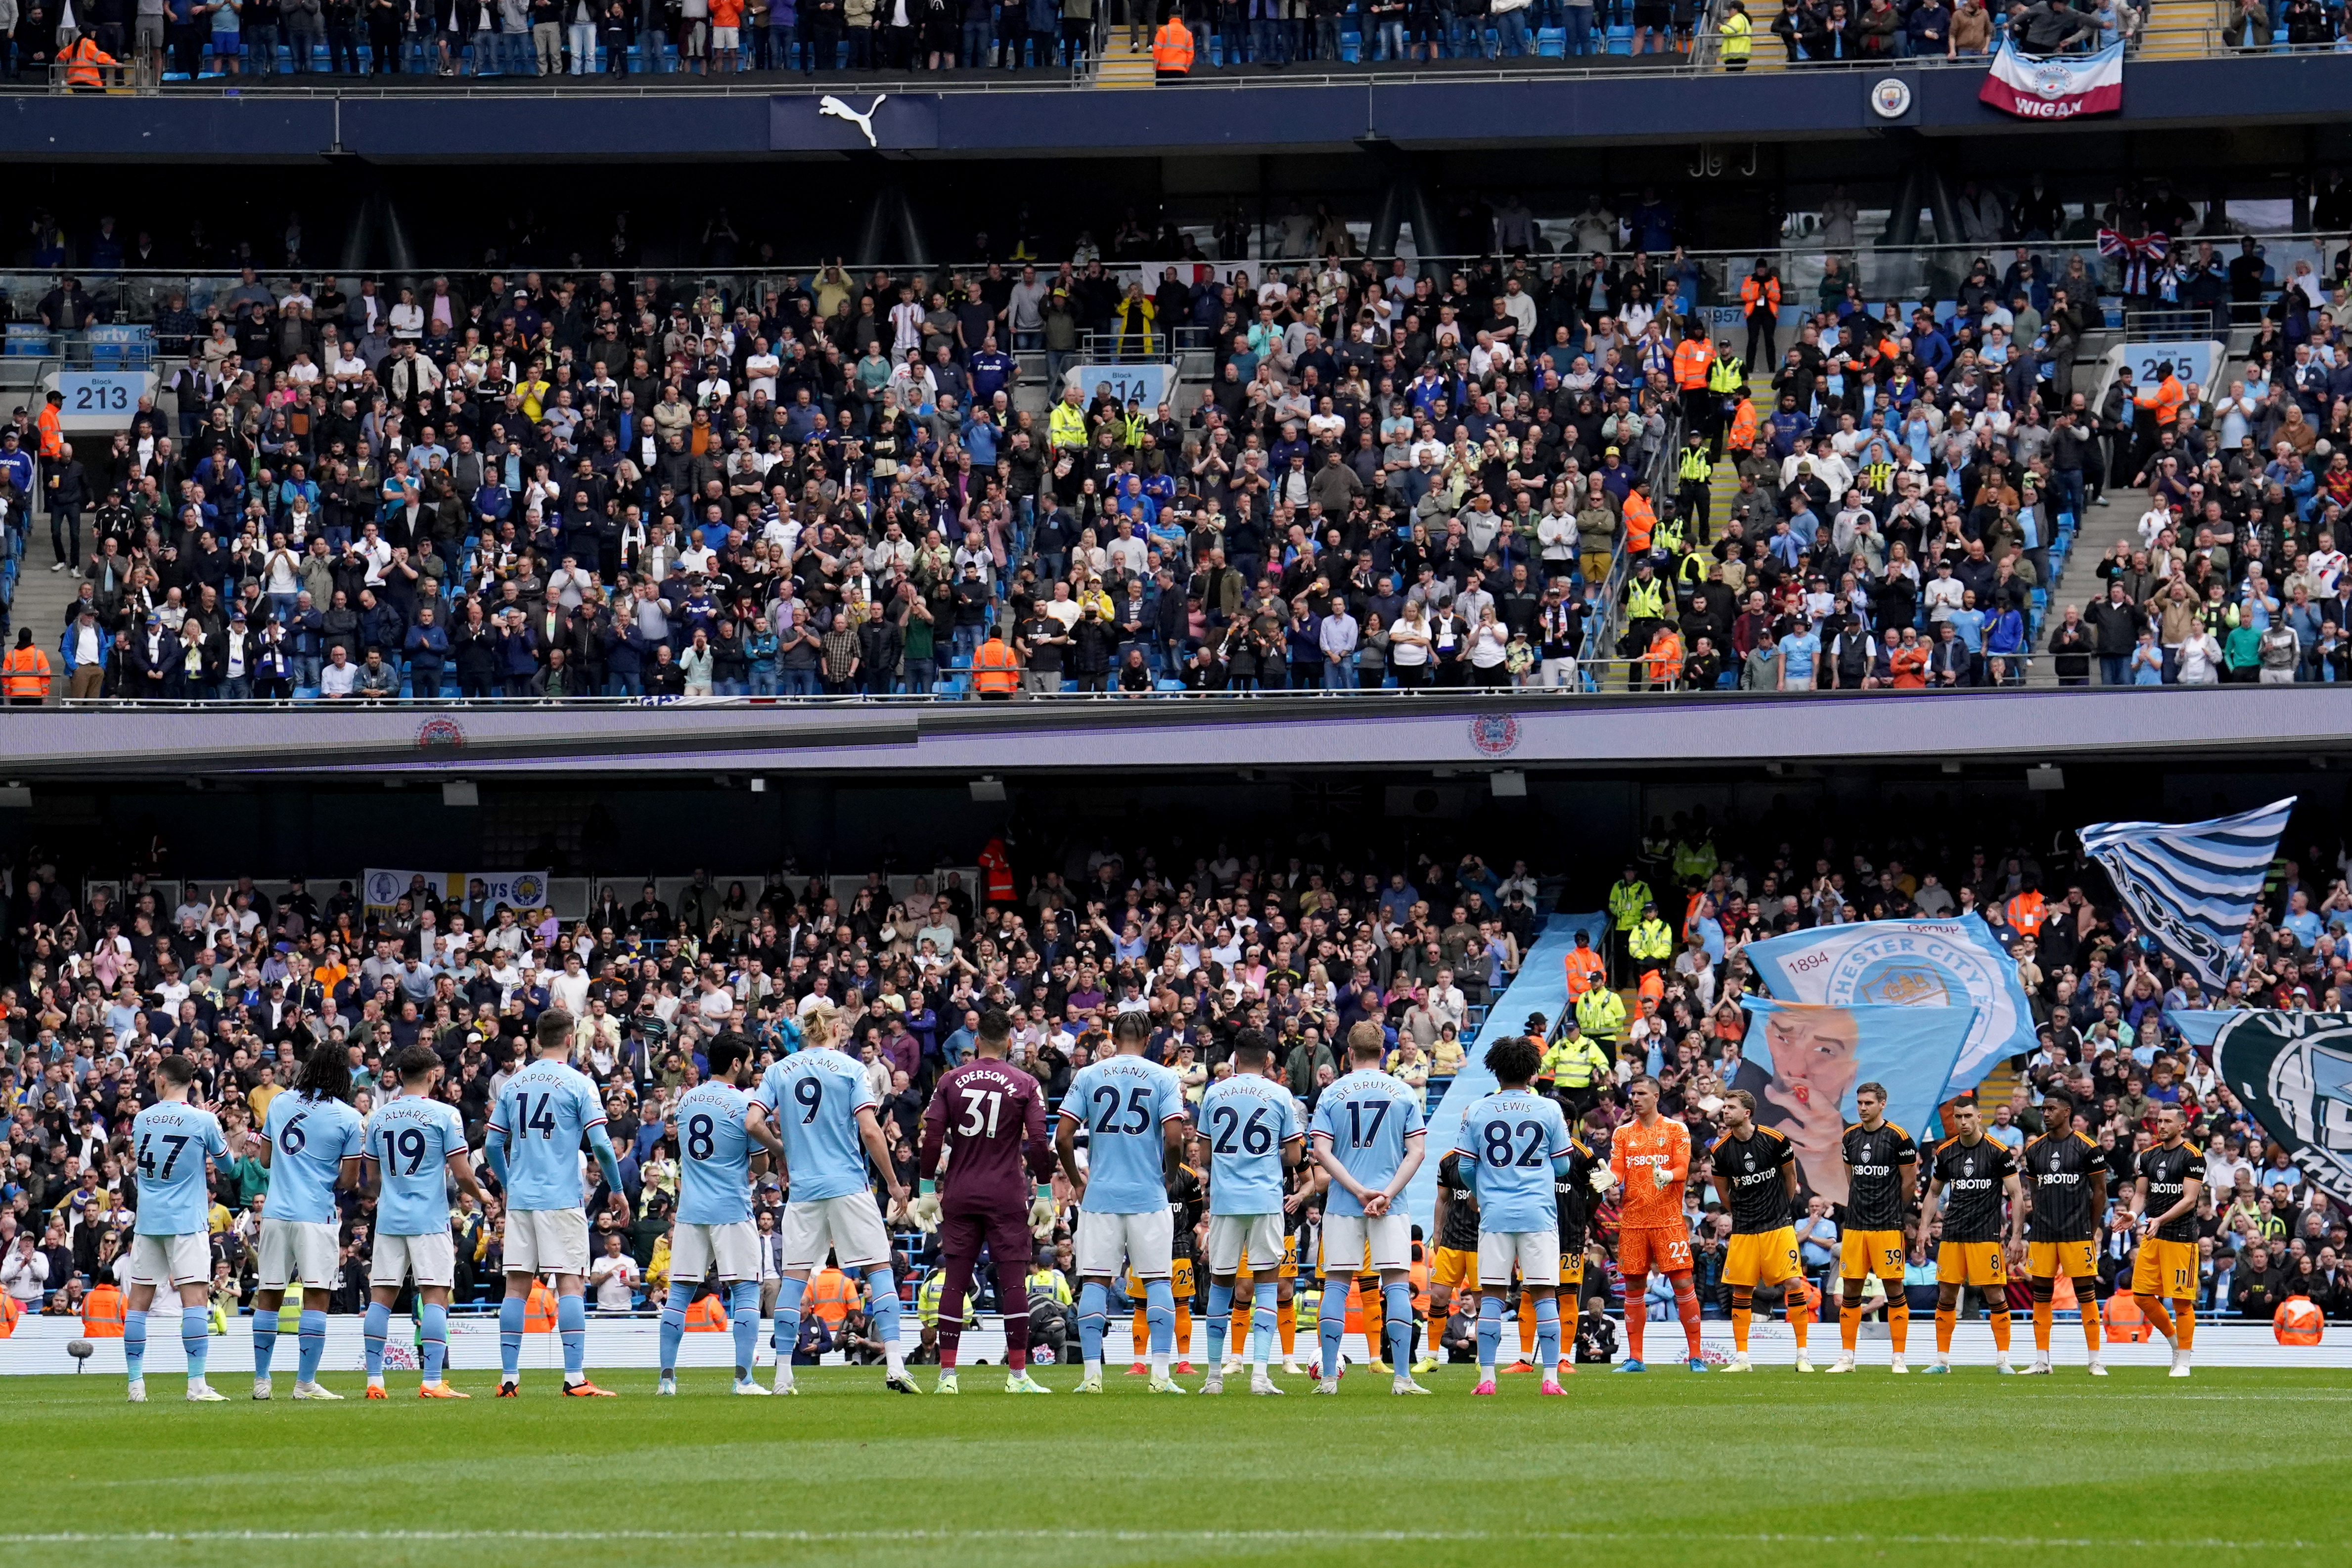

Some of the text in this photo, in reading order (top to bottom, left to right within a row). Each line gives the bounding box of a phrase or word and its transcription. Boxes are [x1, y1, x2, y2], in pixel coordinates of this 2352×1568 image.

[2015, 96, 2083, 117] WIGAN
[2142, 358, 2193, 382] 25
[77, 387, 128, 409] 213
[1788, 951, 1829, 974] 1894
[782, 1057, 840, 1074] HAALAND
[1103, 1066, 1150, 1081] AKANJI
[514, 1073, 565, 1090] LAPORTE
[954, 1069, 1018, 1097] EDERSON M.
[1336, 1080, 1402, 1101] DE BRUYNE
[794, 1076, 822, 1125] 9
[1219, 1086, 1272, 1103] MAHREZ
[515, 1092, 555, 1140] 14
[957, 1088, 1003, 1139] 31
[1093, 1085, 1153, 1136] 25
[1494, 1101, 1532, 1114] LEWIS
[146, 1115, 184, 1128] FODEN
[385, 1109, 435, 1128] ALVAREZ
[1346, 1100, 1392, 1148] 17
[278, 1112, 309, 1155] 6
[688, 1114, 715, 1161] 8
[1212, 1106, 1271, 1156] 26
[382, 1127, 426, 1177] 19
[1484, 1120, 1544, 1168] 82
[137, 1133, 190, 1179] 47
[1741, 1167, 1777, 1187] SBOTOP
[1854, 1165, 1890, 1176] SBOTOP
[2189, 1165, 2205, 1174] wish
[1956, 1178, 1991, 1190] SBOTOP
[2043, 1173, 2079, 1185] SBOTOP
[2151, 1182, 2183, 1194] SBOTOP
[1281, 1248, 1297, 1265] 25
[1668, 1240, 1689, 1258] 22
[1789, 1250, 1798, 1265] 9
[1885, 1249, 1902, 1265] 39
[2083, 1247, 2092, 1263] 3
[1560, 1253, 1580, 1271] 28
[1990, 1254, 1999, 1270] 8
[1178, 1267, 1194, 1285] 29
[2175, 1268, 2186, 1286] 11
